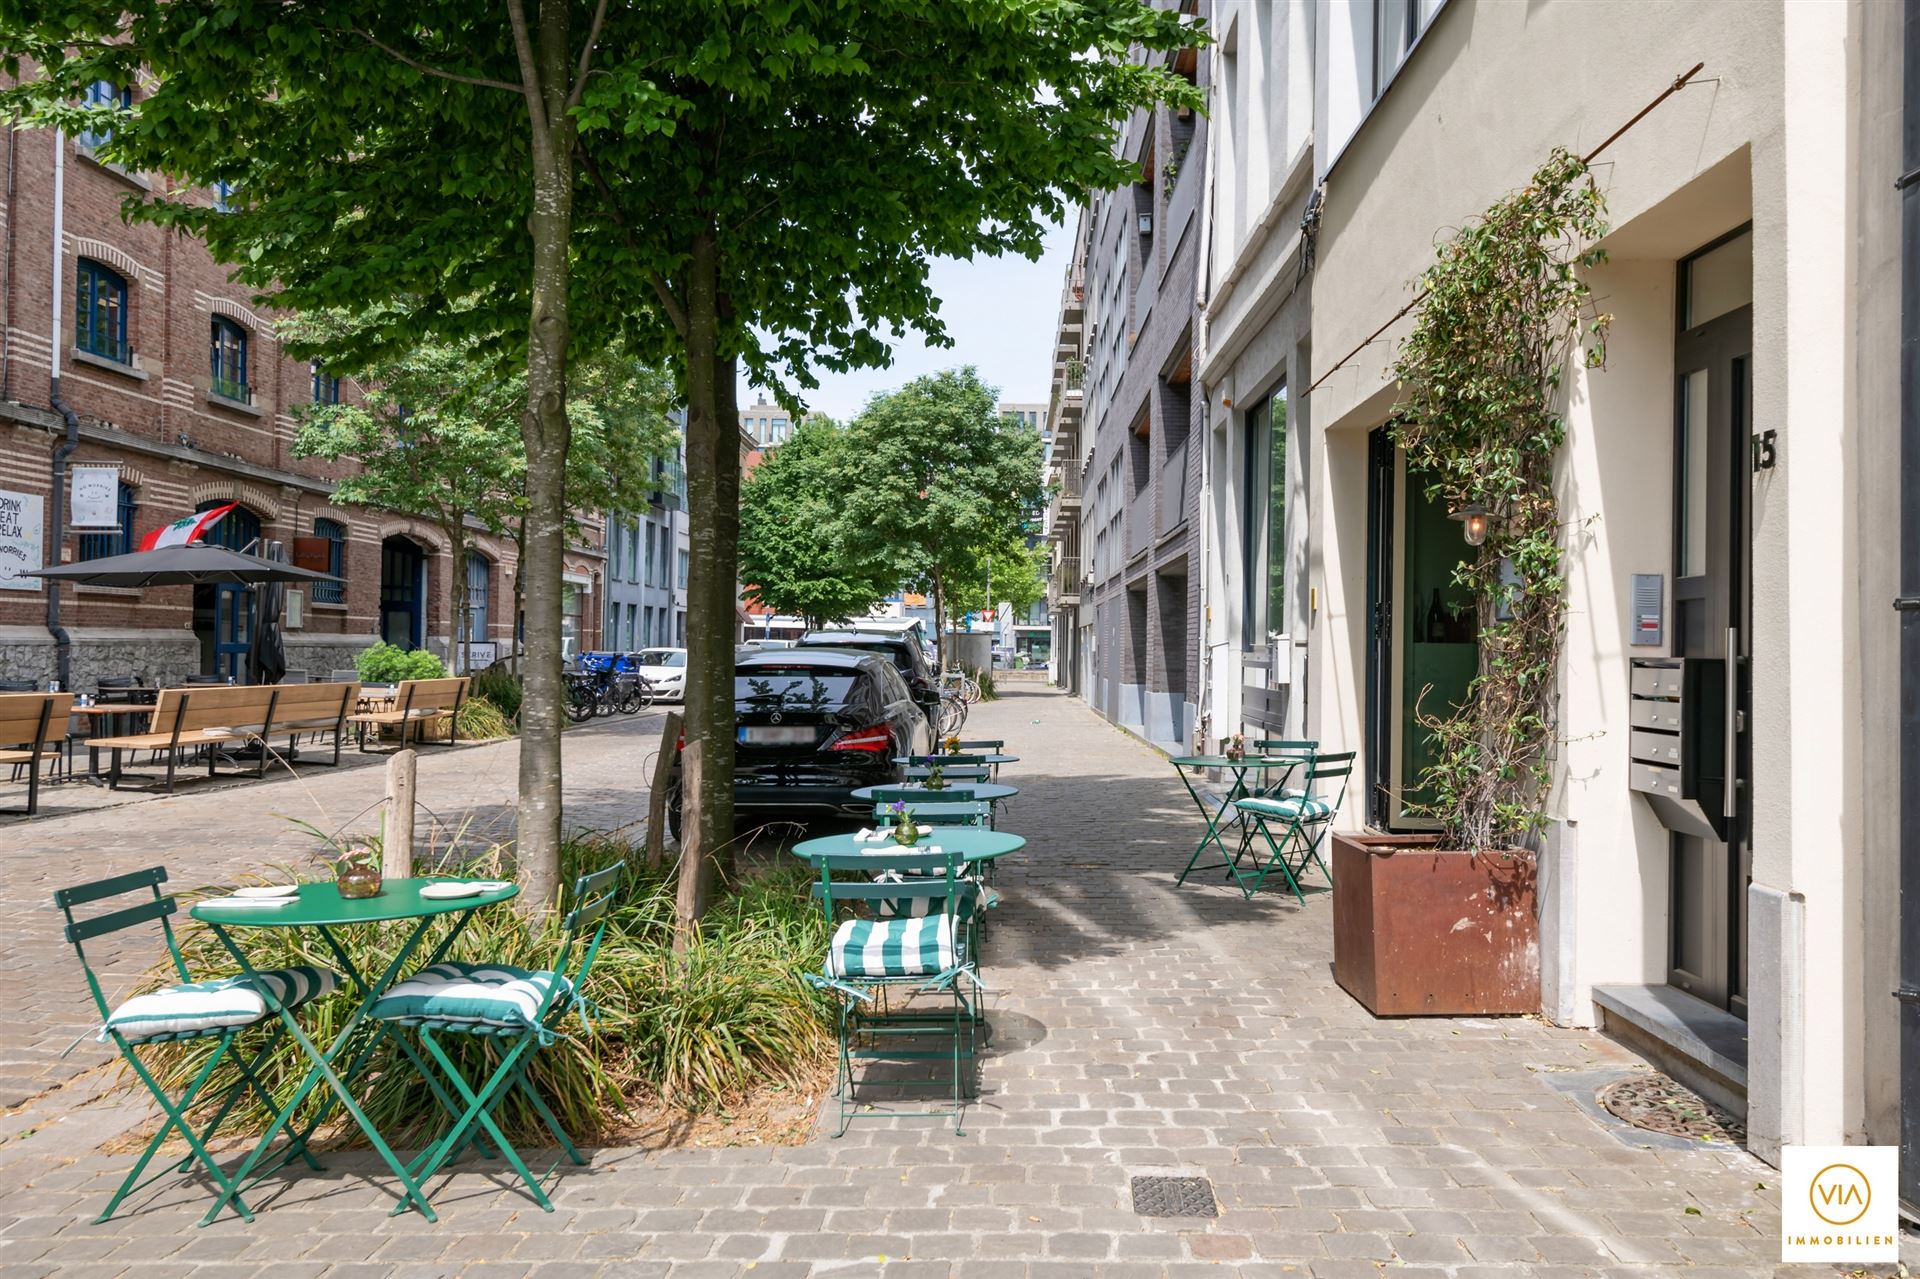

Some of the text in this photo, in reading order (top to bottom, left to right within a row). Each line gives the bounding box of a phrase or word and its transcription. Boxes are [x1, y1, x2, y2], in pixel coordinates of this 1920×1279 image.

[1752, 429, 1777, 472] 15
[0, 497, 21, 512] DRINK
[0, 511, 19, 525] EAT
